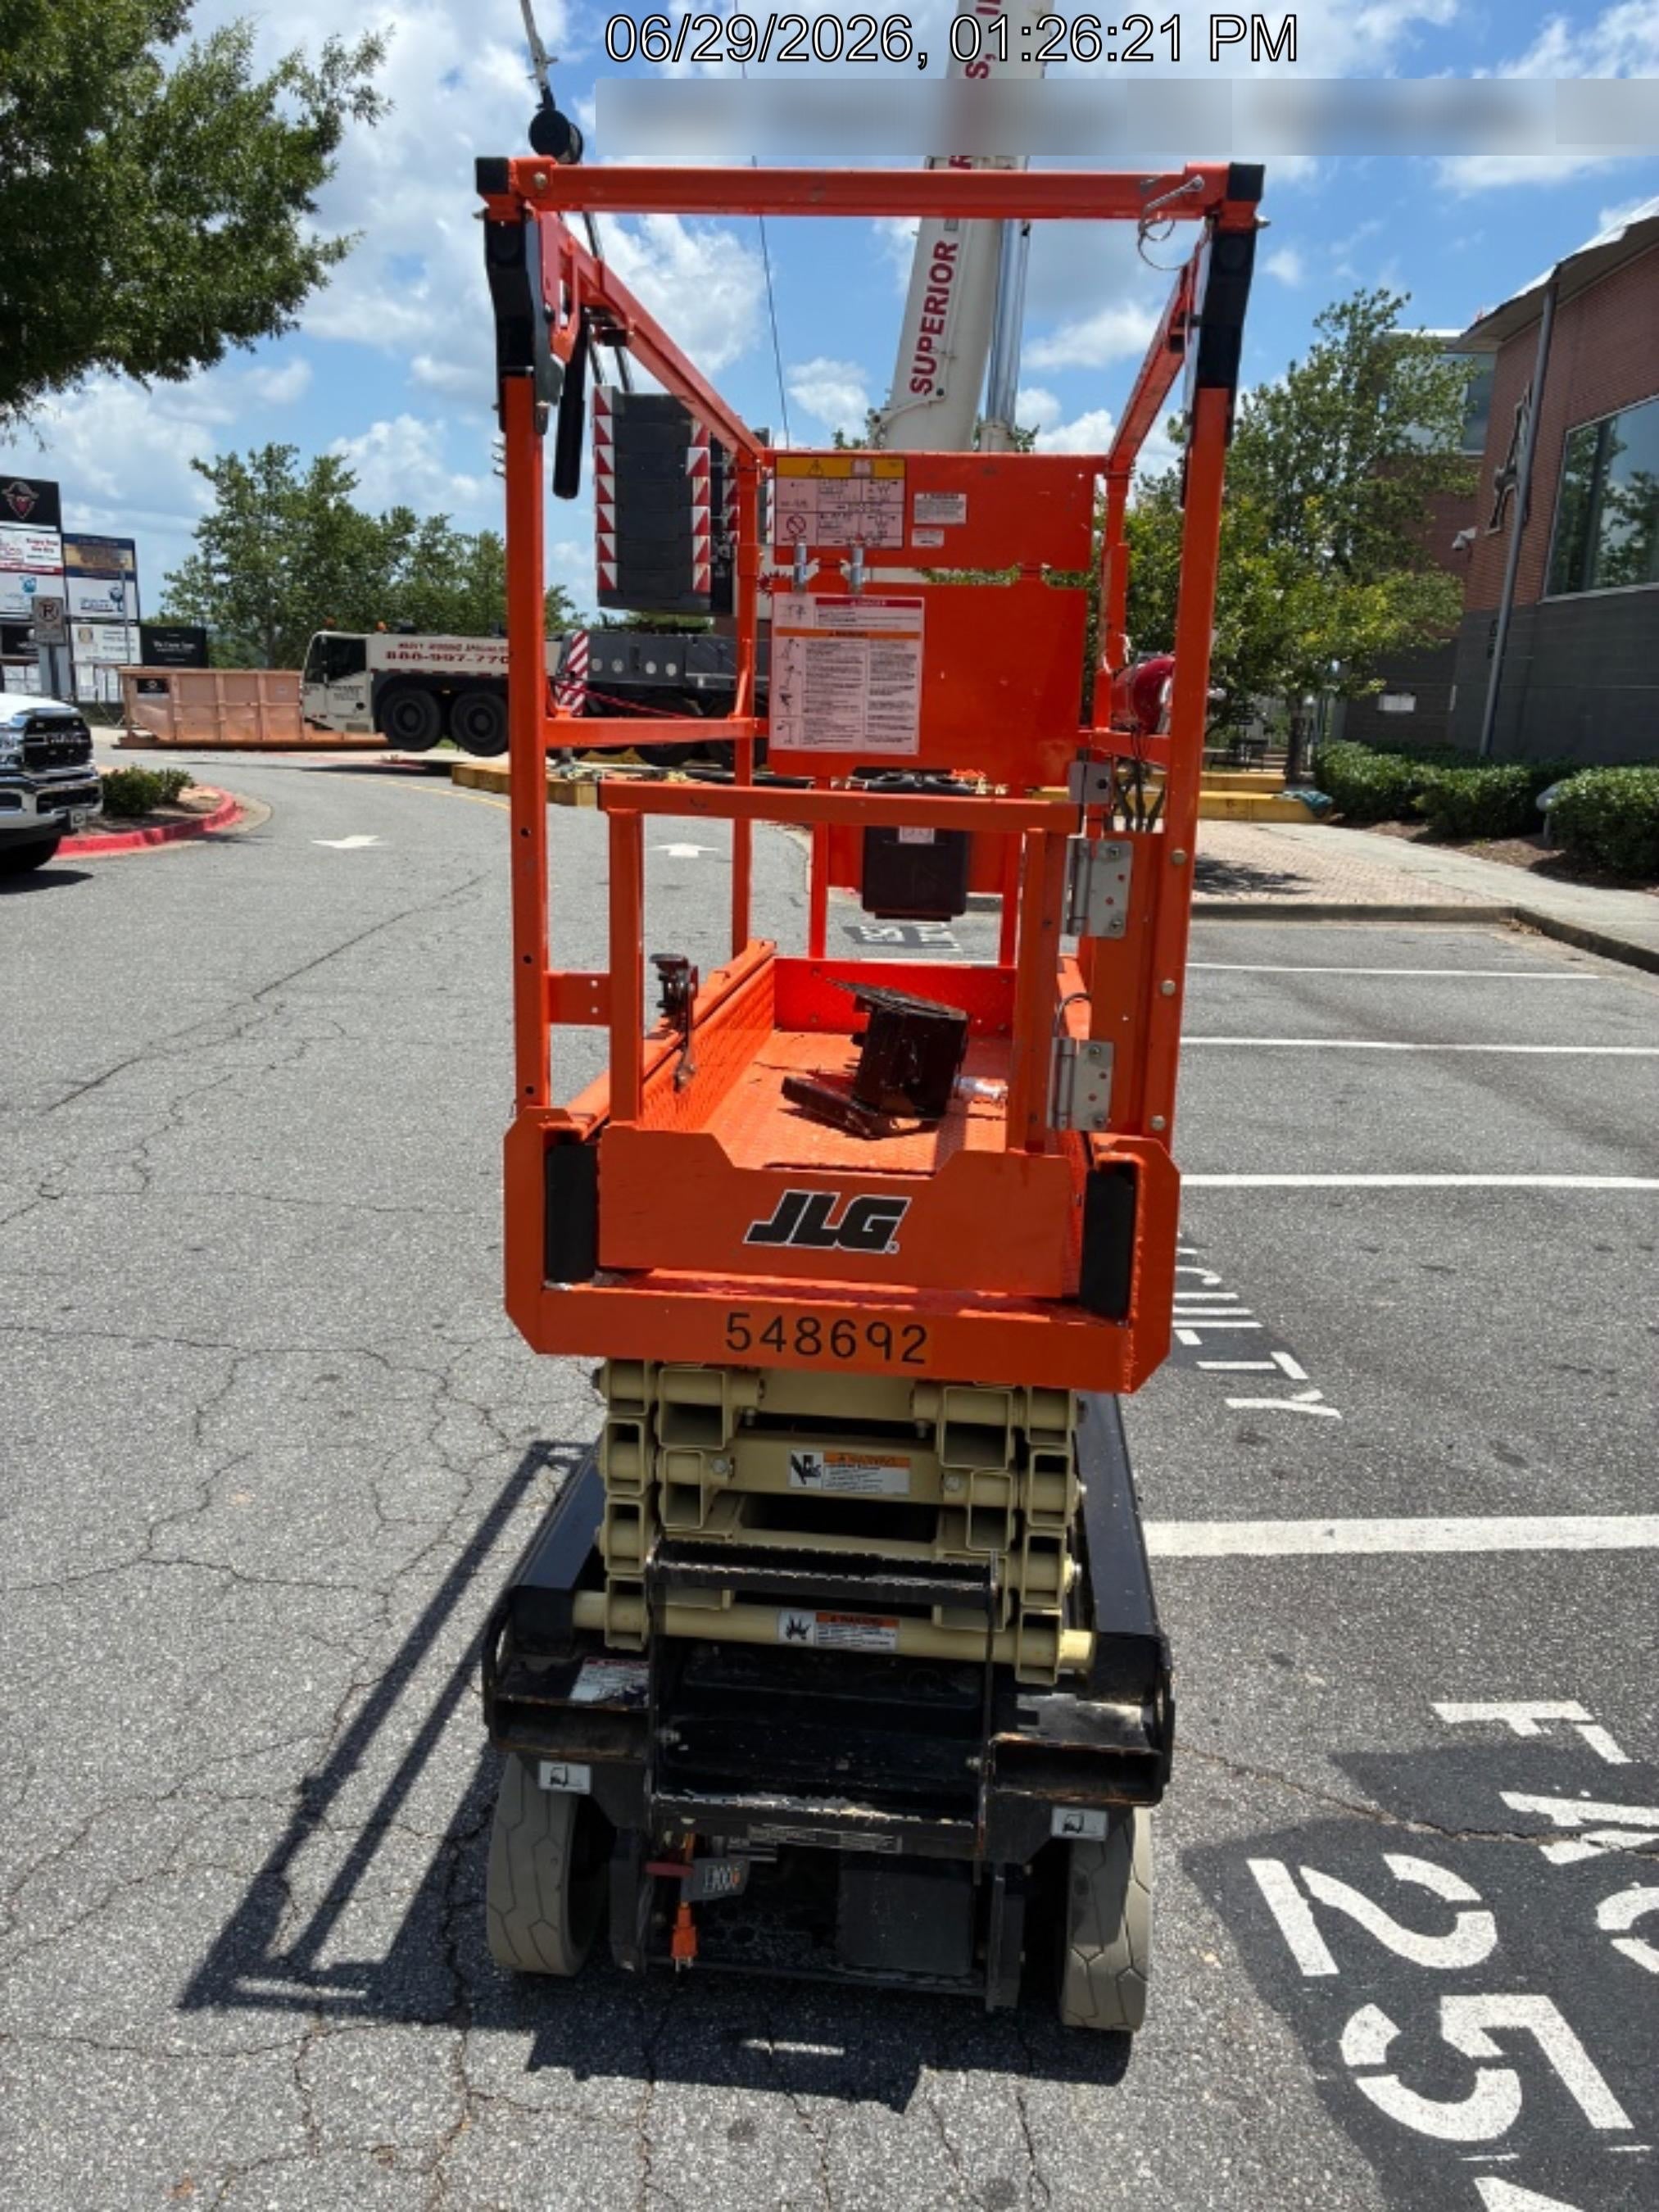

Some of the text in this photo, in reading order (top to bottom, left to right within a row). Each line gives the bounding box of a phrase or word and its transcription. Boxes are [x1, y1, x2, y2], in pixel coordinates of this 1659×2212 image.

[909, 240, 959, 396] SUPERIOR
[742, 1190, 912, 1253] JLG
[725, 1312, 927, 1365] 548692
[1246, 1852, 1635, 2142] 25
